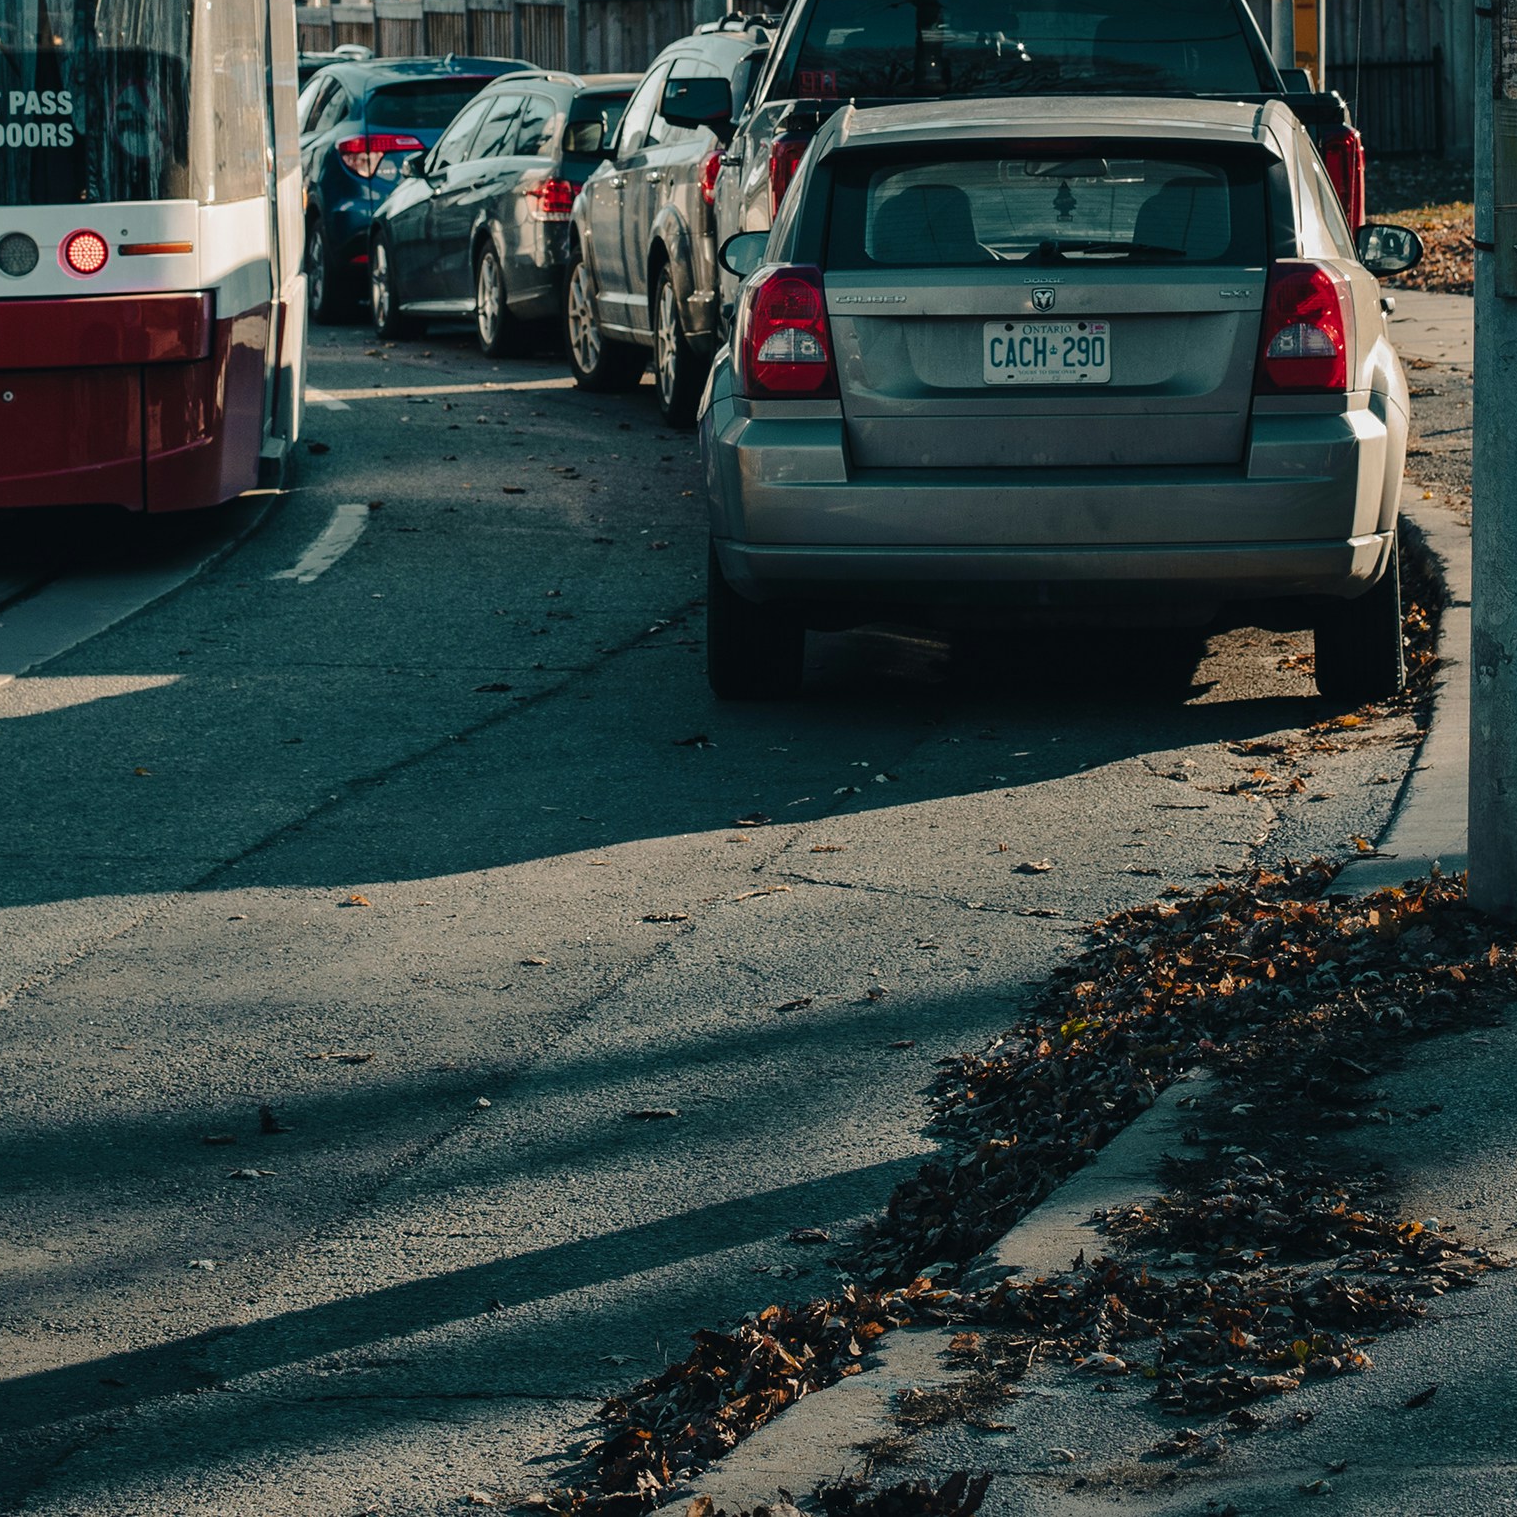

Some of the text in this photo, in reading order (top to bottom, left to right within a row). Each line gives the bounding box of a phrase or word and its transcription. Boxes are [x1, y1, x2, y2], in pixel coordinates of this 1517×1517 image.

[9, 90, 73, 115] PASS
[835, 295, 907, 304] CALIBER
[990, 336, 1105, 368] CACH 290
